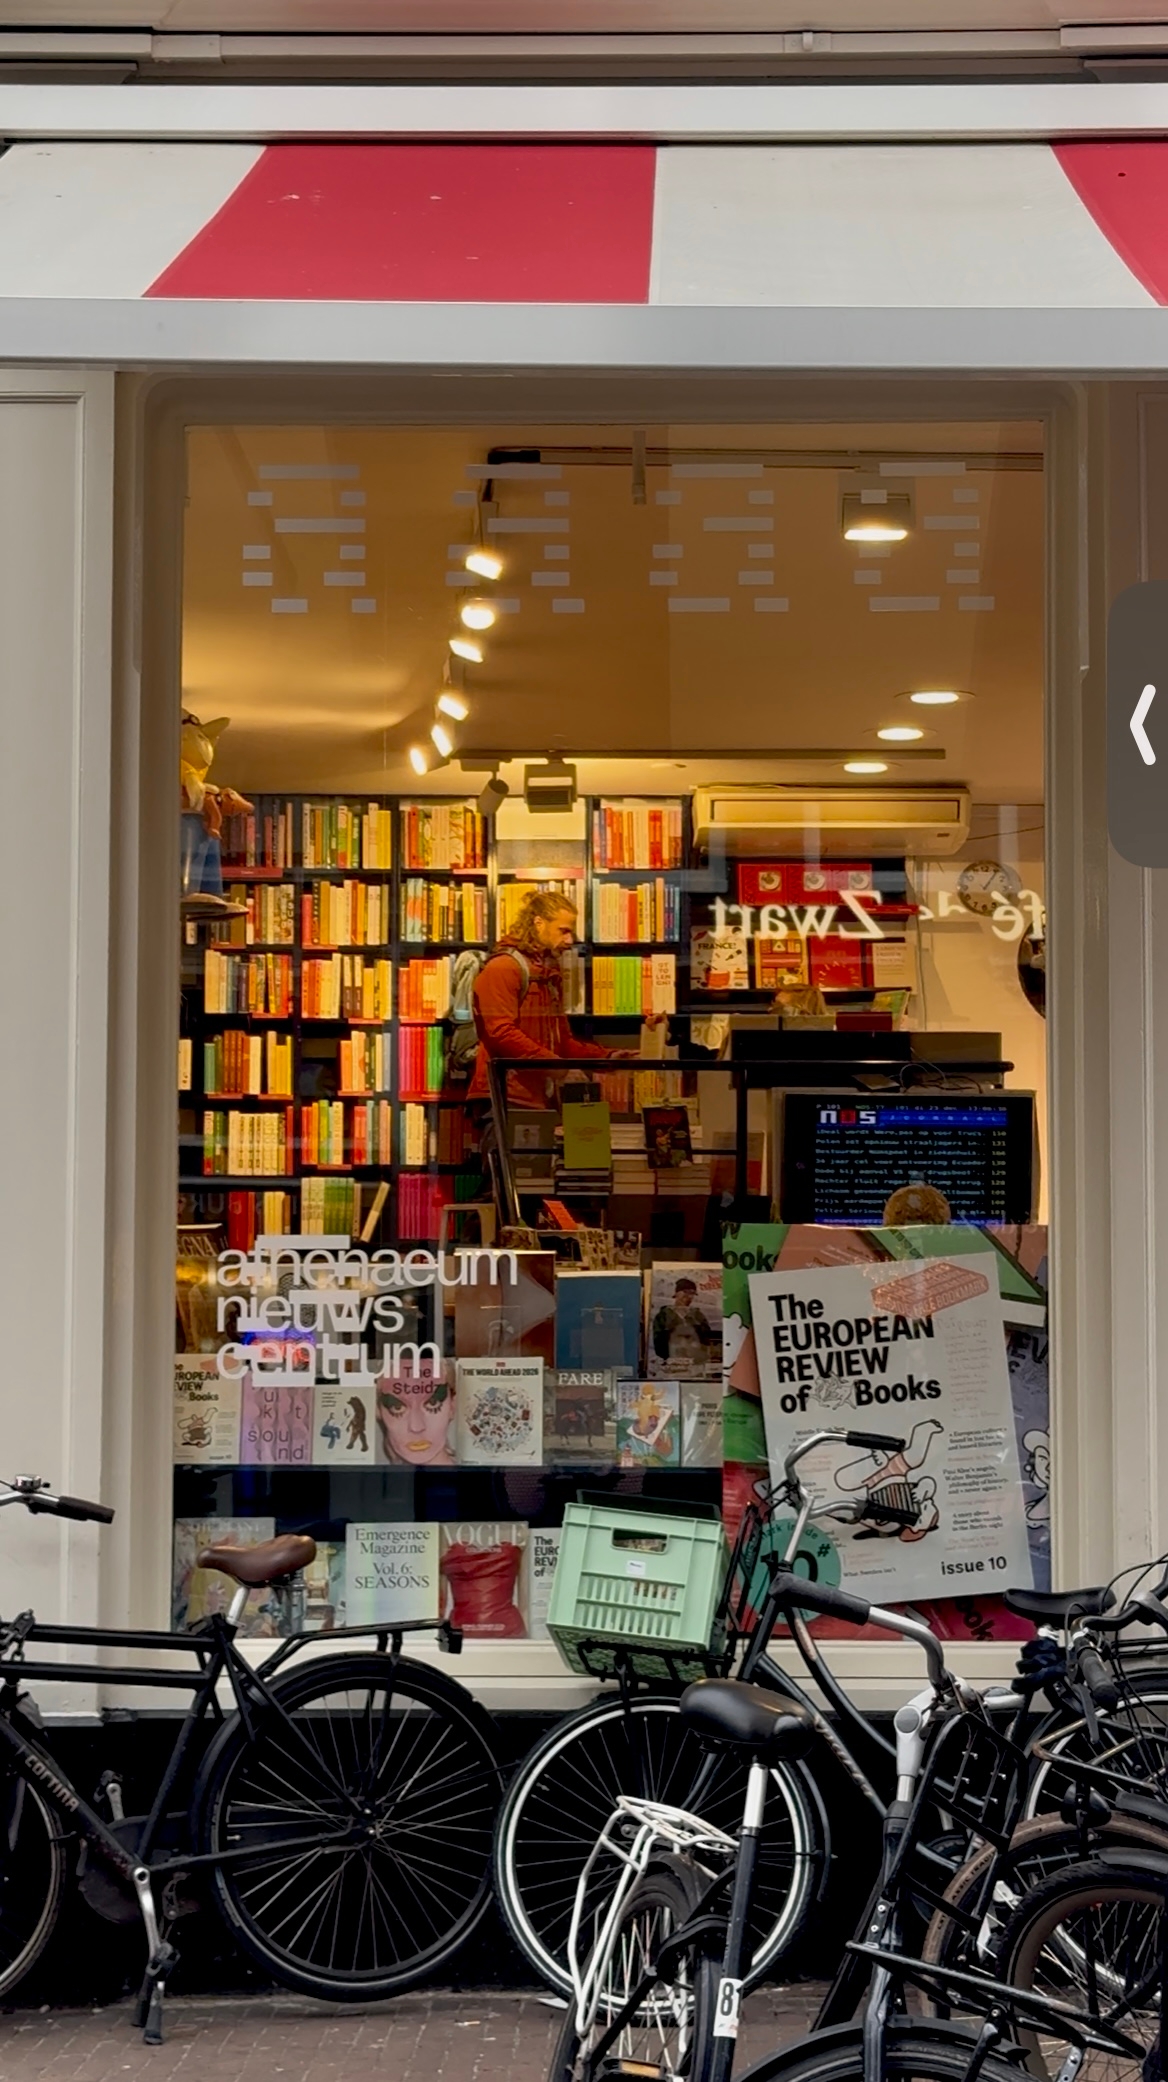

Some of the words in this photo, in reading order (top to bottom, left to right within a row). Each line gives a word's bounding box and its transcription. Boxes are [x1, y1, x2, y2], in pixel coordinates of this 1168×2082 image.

[216, 1236, 518, 1287] athenaeum
[216, 1286, 405, 1333] nieuws
[768, 1293, 824, 1322] The
[773, 1314, 935, 1353] EUROPEAN
[216, 1333, 441, 1380] centrum
[776, 1346, 889, 1383] REVIEW
[462, 1368, 474, 1376] THE
[476, 1368, 499, 1376] WORLD
[500, 1368, 521, 1376] AHEAD
[558, 1372, 604, 1386] FARE
[189, 1391, 220, 1402] Books
[780, 1384, 812, 1414] of
[854, 1374, 942, 1406] Books
[355, 1528, 431, 1544] Emergence
[441, 1524, 527, 1547] VOGUE
[534, 1536, 554, 1546] The
[360, 1540, 426, 1558] Magazine
[534, 1546, 560, 1557] EURO
[373, 1562, 399, 1575] Vol.
[401, 1562, 413, 1575] 6:
[534, 1557, 558, 1567] REV
[941, 1561, 985, 1576] issue
[988, 1555, 1008, 1571] 10
[534, 1568, 545, 1578] of
[355, 1575, 430, 1590] SEASONS
